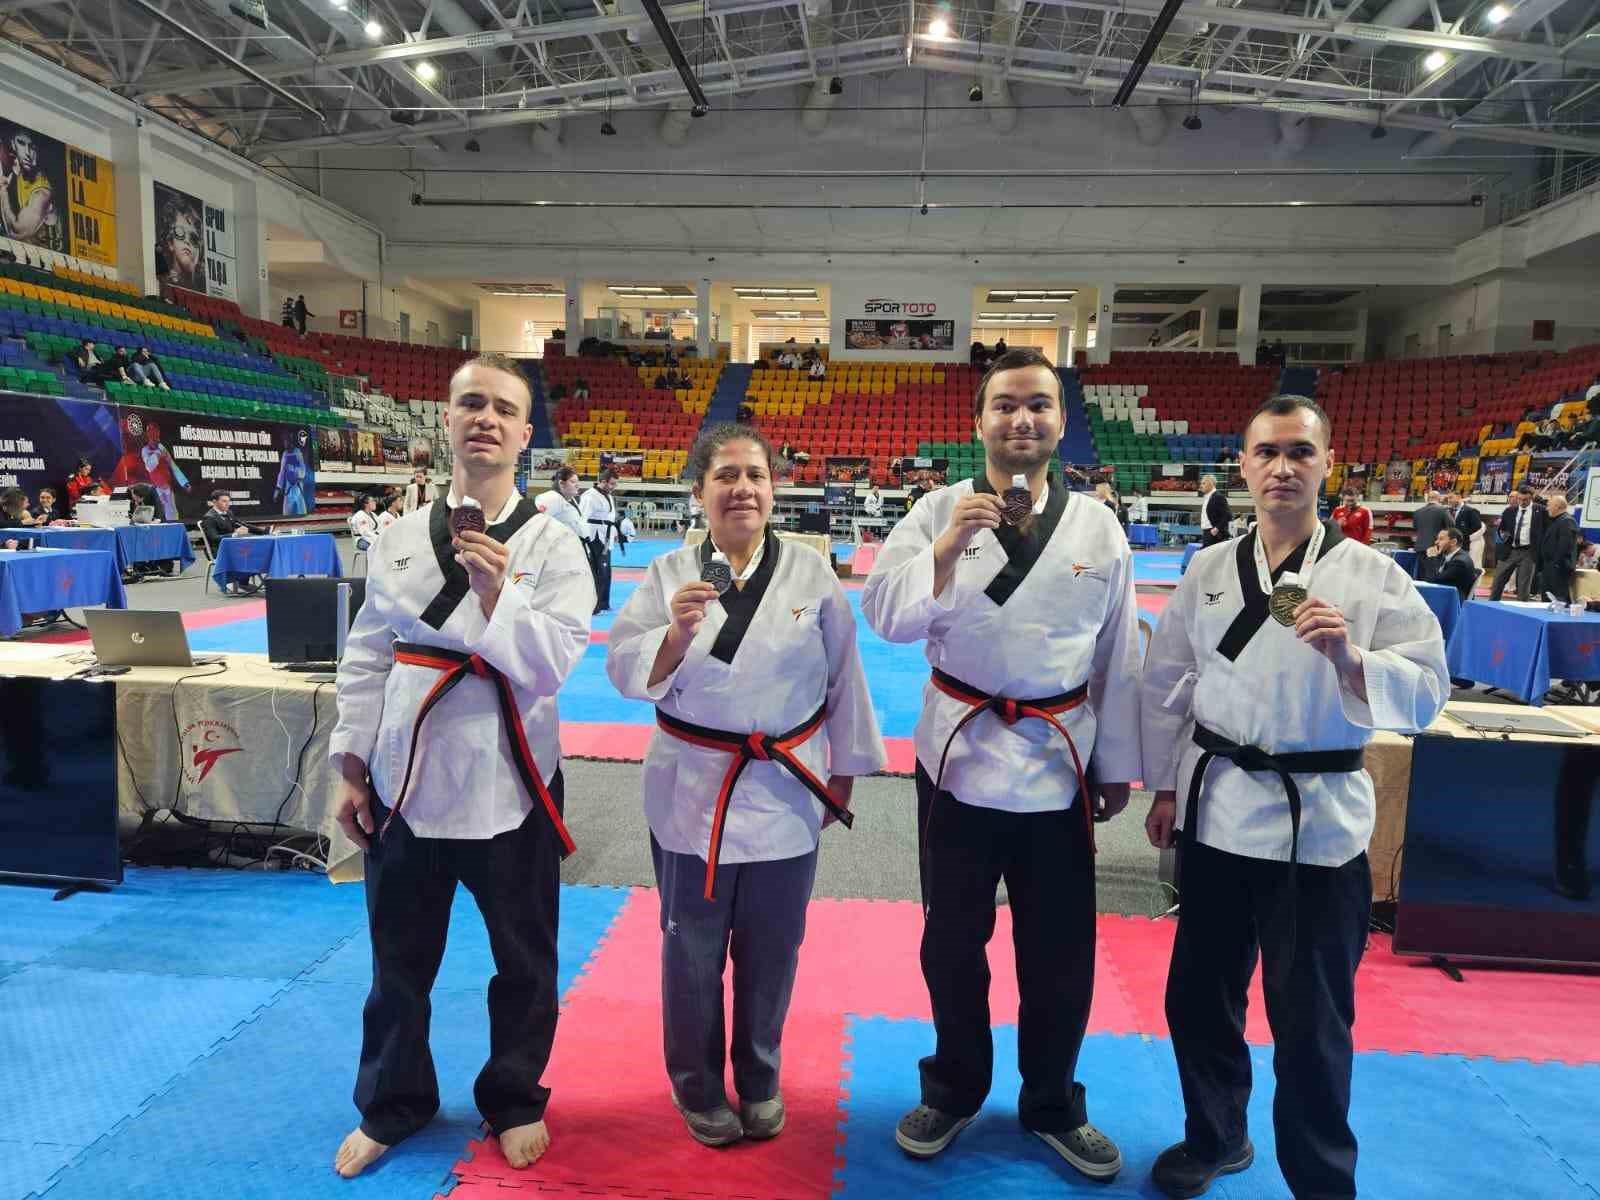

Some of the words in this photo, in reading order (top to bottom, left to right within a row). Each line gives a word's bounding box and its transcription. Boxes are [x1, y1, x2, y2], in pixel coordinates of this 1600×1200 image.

[207, 229, 217, 253] LA
[16, 438, 34, 453] TÜM
[258, 431, 272, 446] TÜM
